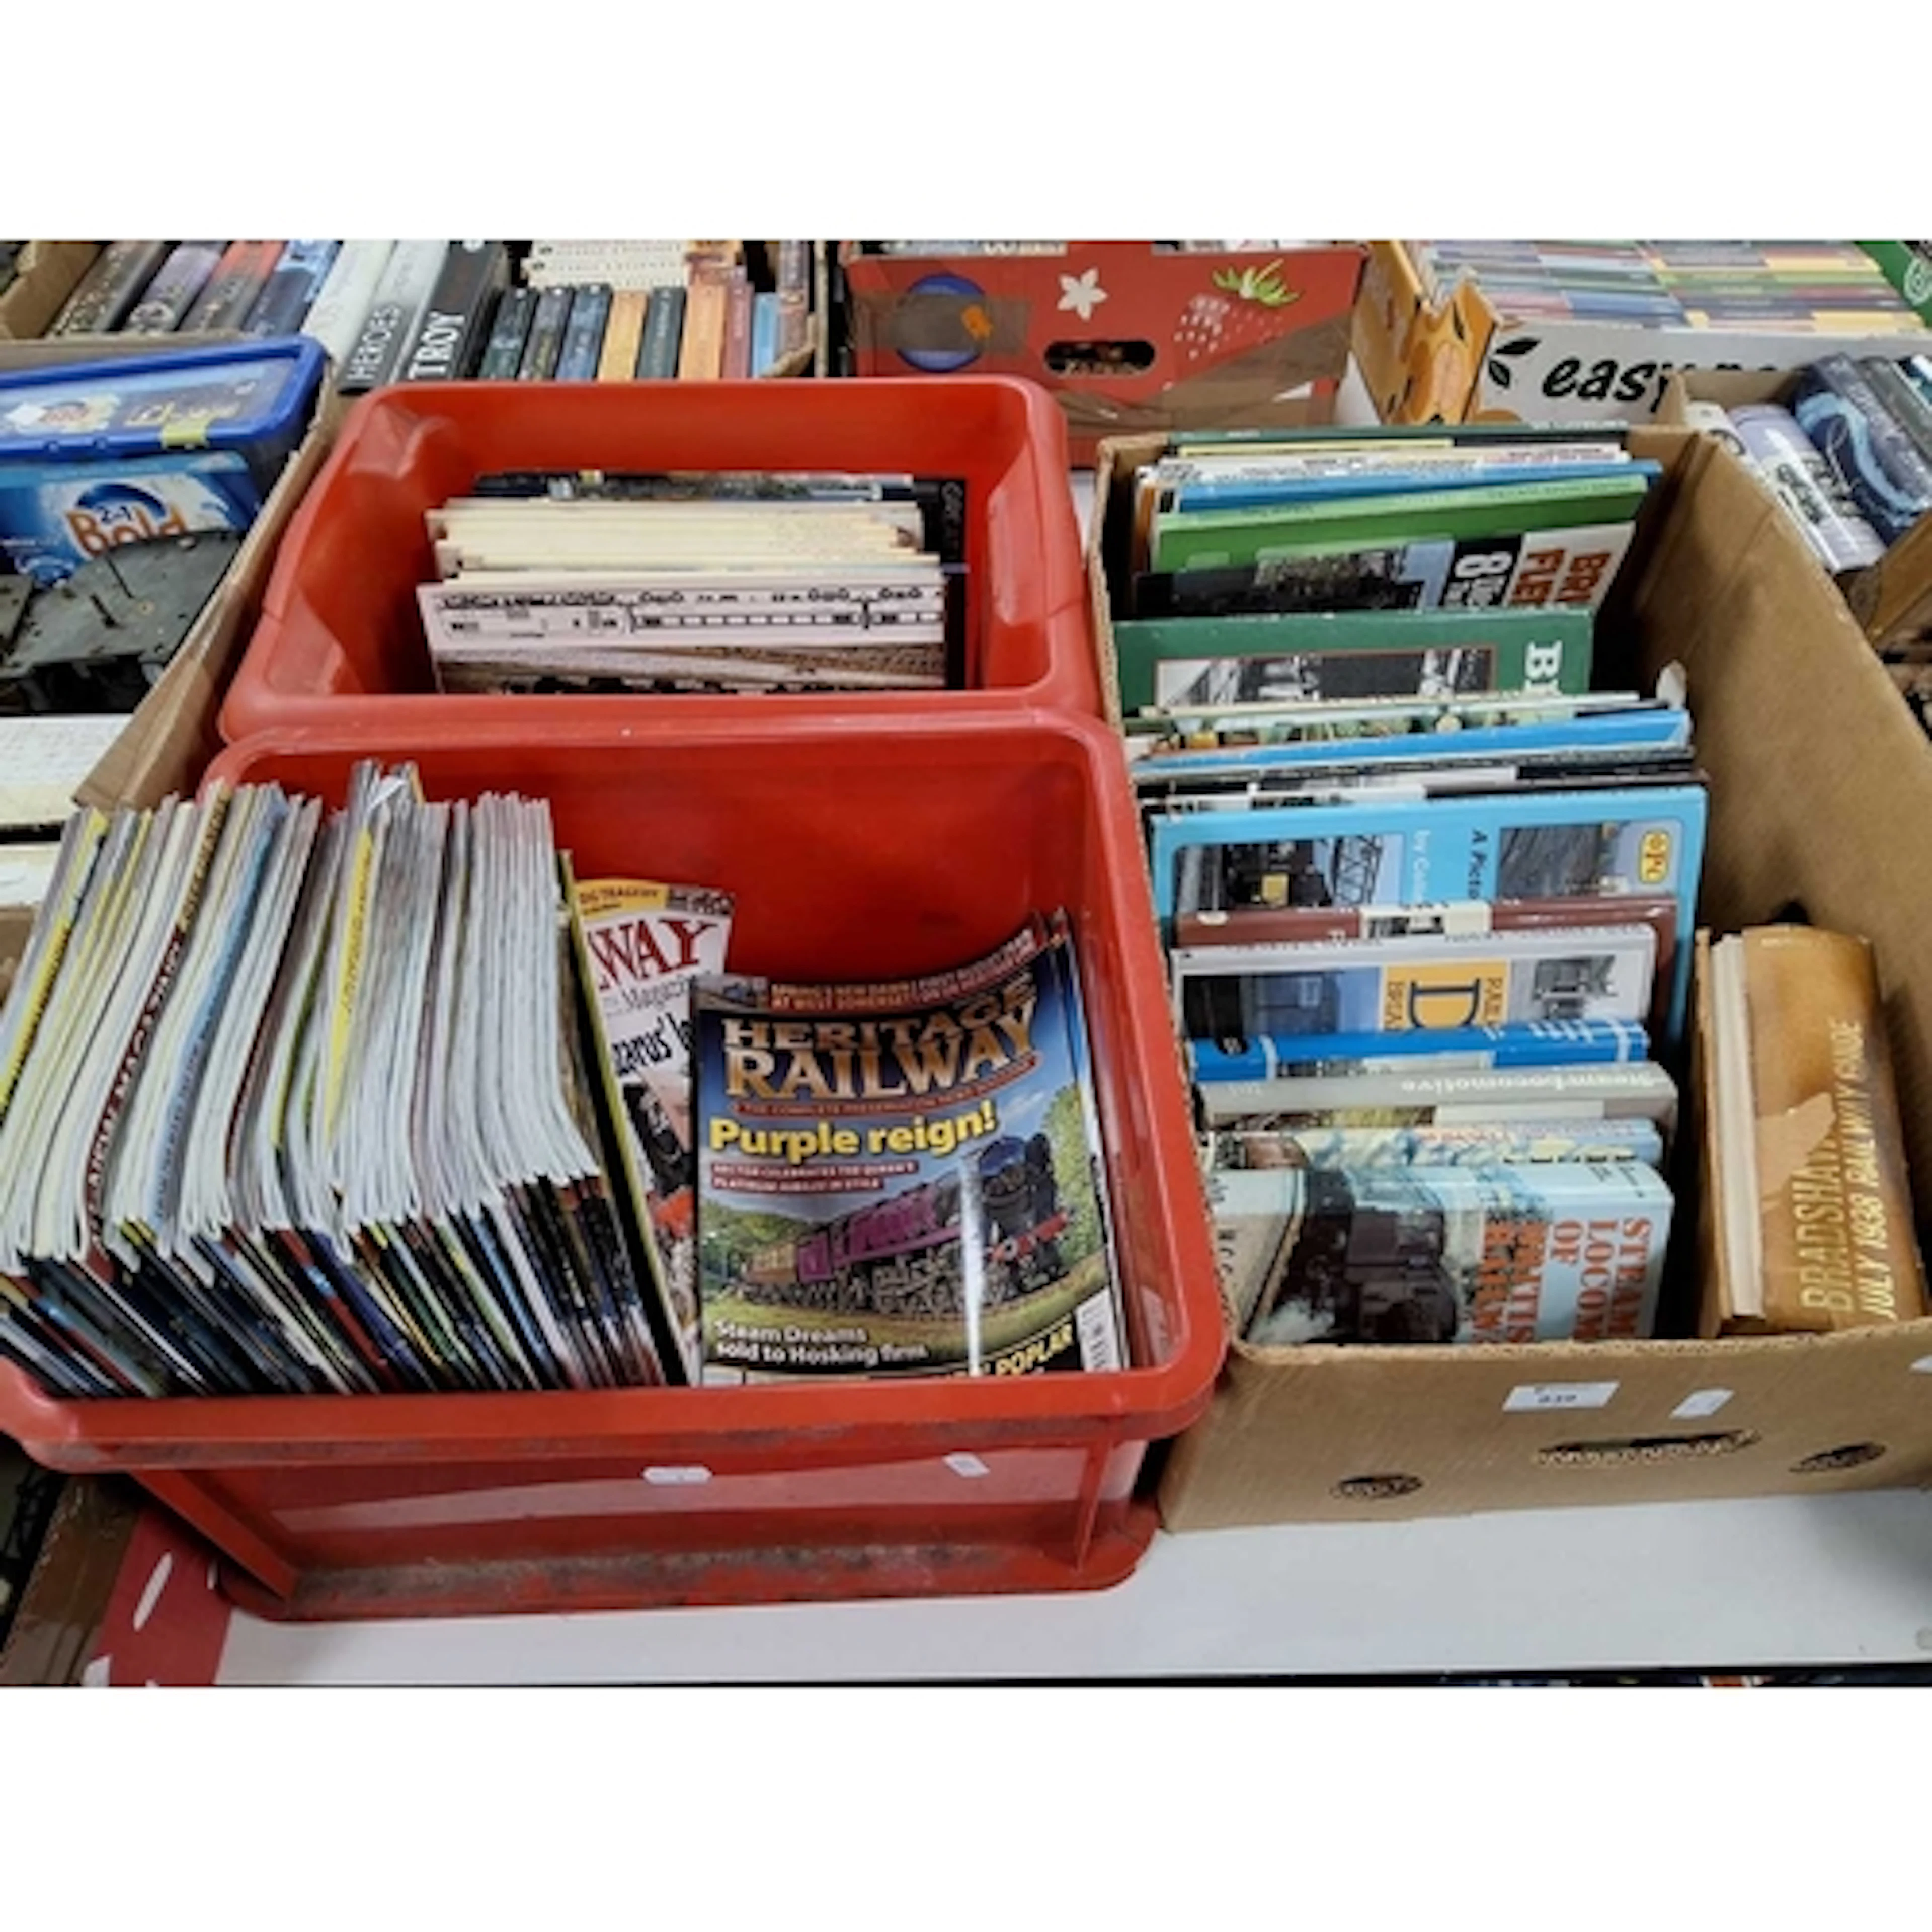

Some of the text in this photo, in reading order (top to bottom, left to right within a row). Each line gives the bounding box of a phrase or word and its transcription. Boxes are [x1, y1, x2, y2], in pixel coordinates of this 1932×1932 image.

[347, 307, 403, 381] HEROES
[407, 311, 466, 381] TROY
[66, 503, 188, 557] Bold
[587, 918, 718, 990] WAY
[720, 971, 1037, 1051] HERITAGE
[724, 995, 1037, 1100] RAILWAY
[1827, 1016, 1868, 1083] GUIDE
[708, 1098, 998, 1165] Purple reign!
[1834, 1082, 1880, 1189] RAILWAY
[1551, 1220, 1583, 1266] OF
[1848, 1192, 1889, 1251] 1938
[1608, 1218, 1652, 1338] STEAM
[1854, 1250, 1898, 1322] JULY
[713, 1319, 868, 1344] Steam Dreams
[762, 1344, 786, 1361] to
